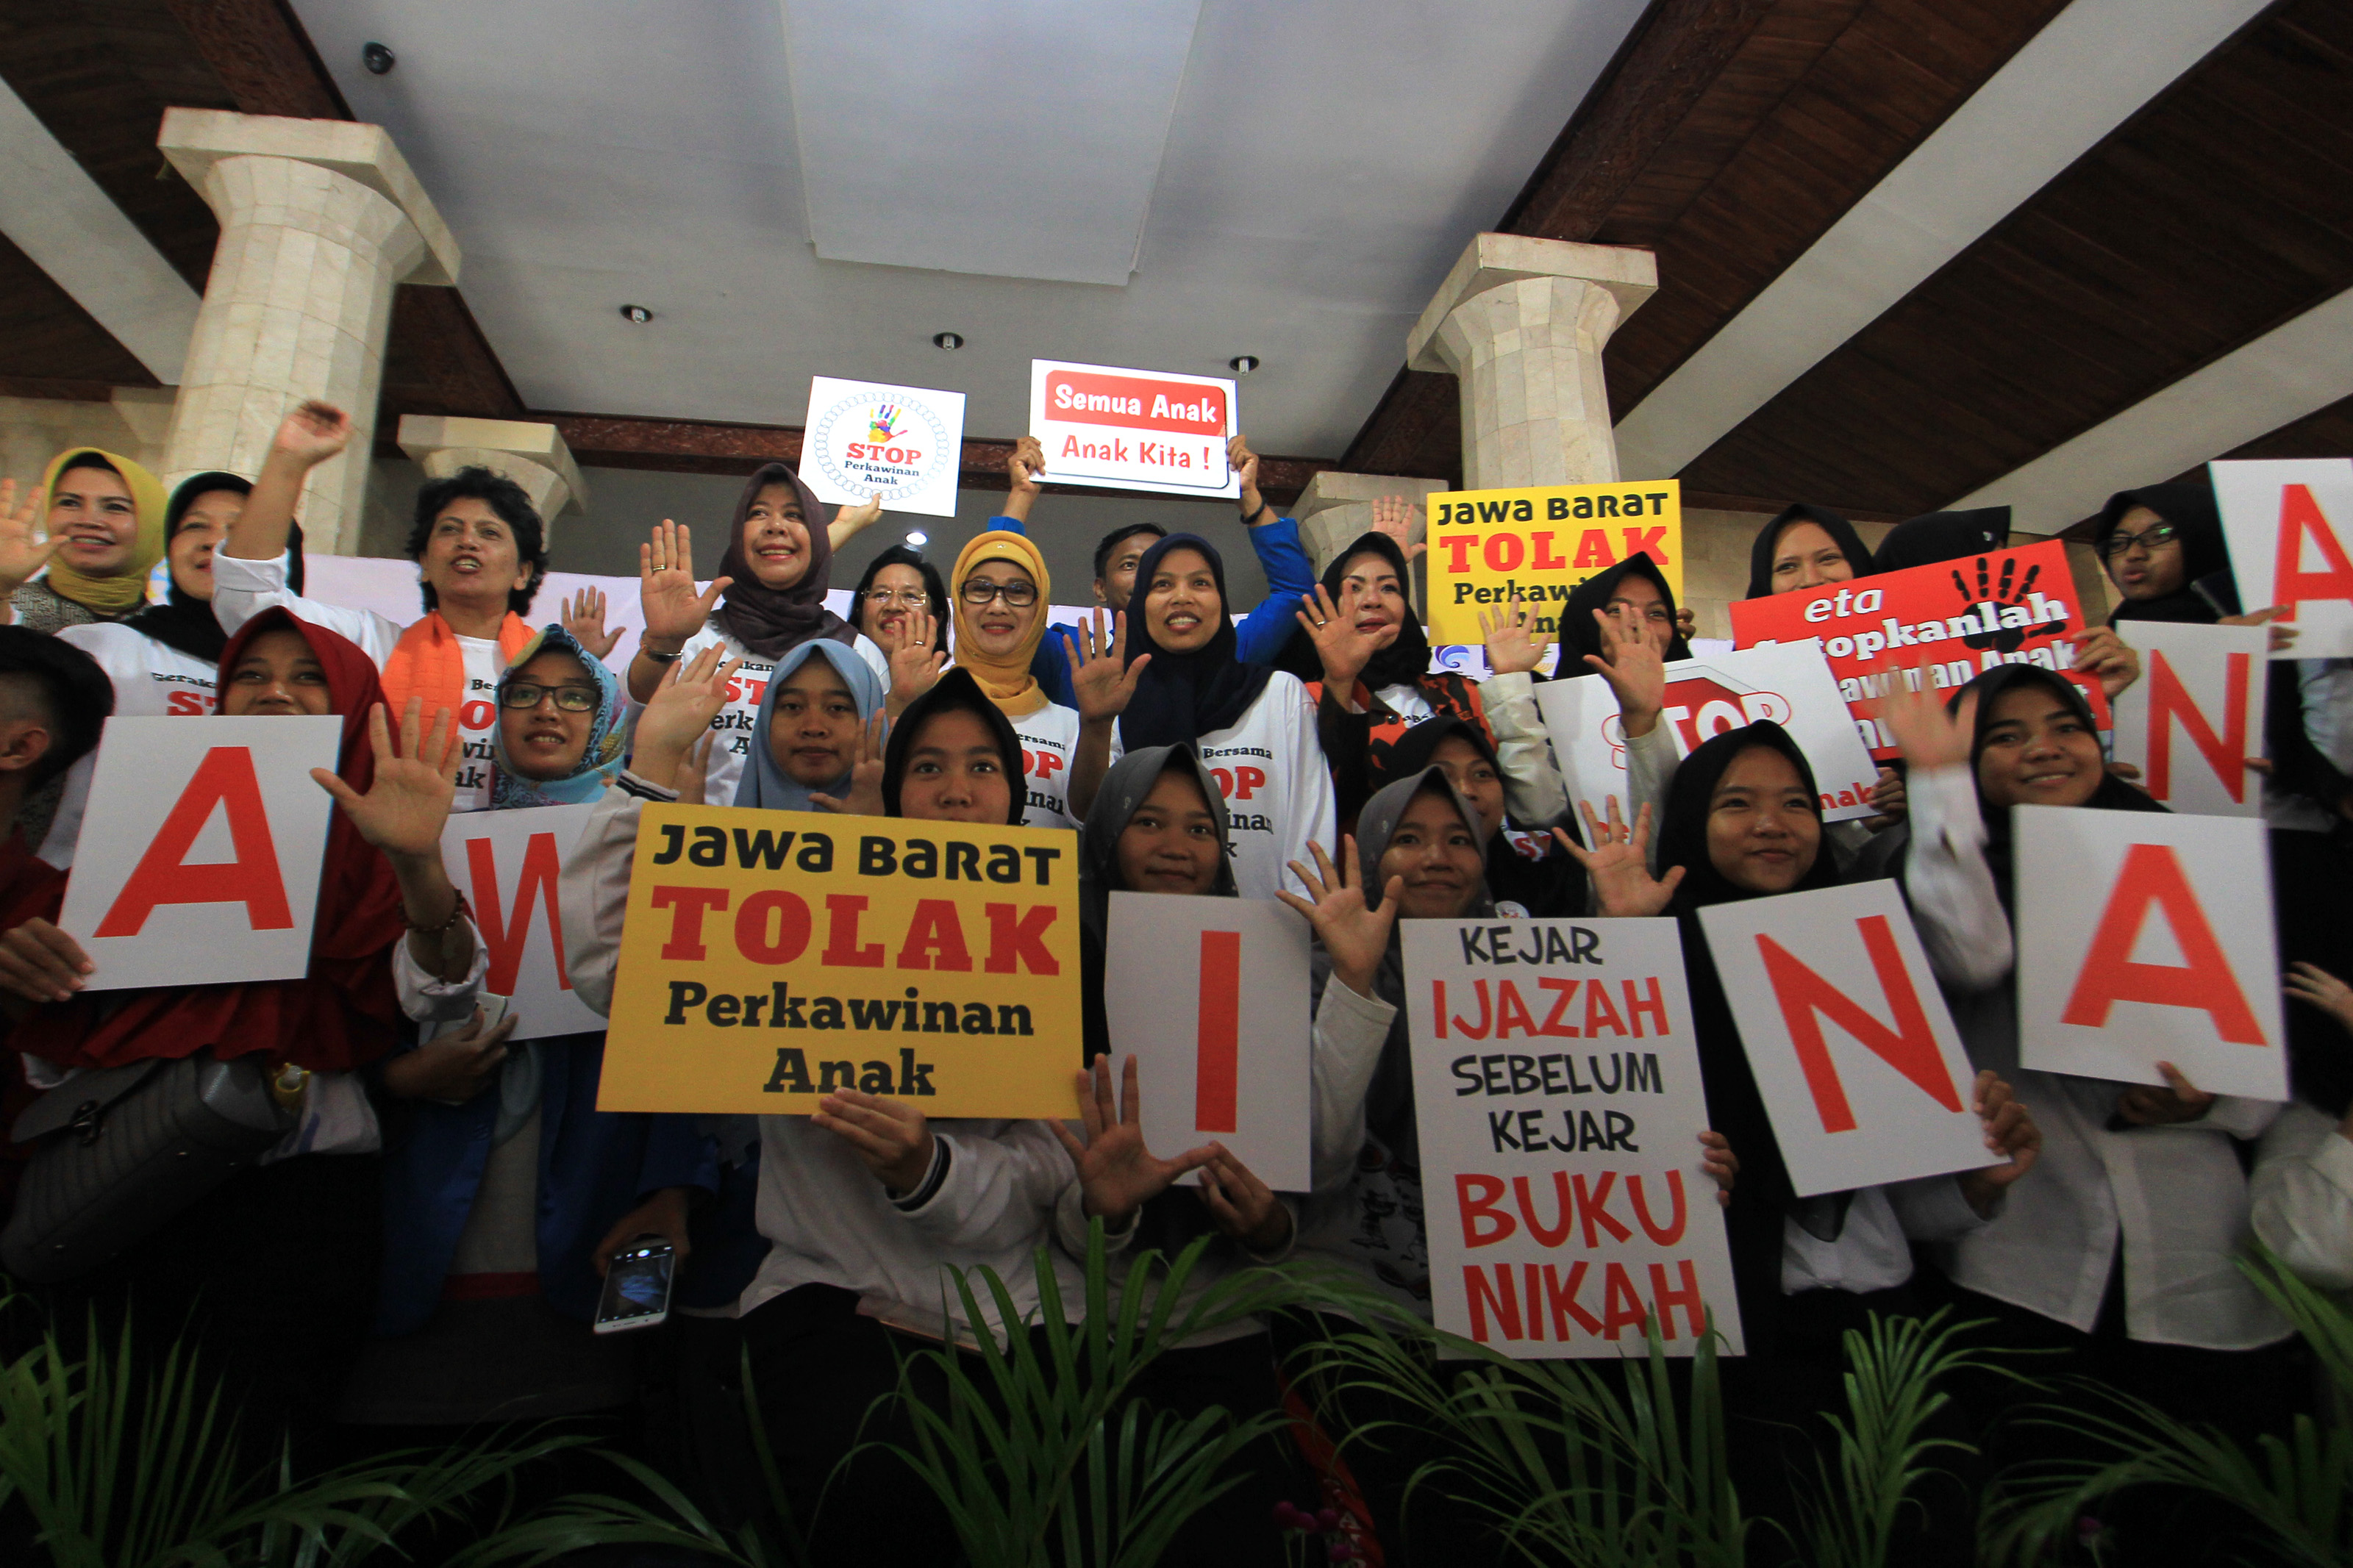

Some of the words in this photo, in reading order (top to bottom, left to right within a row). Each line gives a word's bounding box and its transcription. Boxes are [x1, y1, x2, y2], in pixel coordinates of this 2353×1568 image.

[1054, 384, 1141, 415] Semua
[1151, 394, 1217, 424] Anak
[844, 460, 920, 476] Perkawinan
[846, 443, 921, 465] STOP
[1062, 435, 1128, 462] Anak
[1139, 441, 1192, 469] Kita
[1202, 447, 1210, 470] !
[864, 474, 898, 484] Anak
[1439, 526, 1668, 573] TOLAK
[2271, 484, 2353, 622] A
[1454, 577, 1586, 604] Perkaw
[1804, 588, 1883, 623] eta
[1754, 592, 2068, 659] opkanlah
[2146, 648, 2250, 803] N
[1203, 747, 1273, 759] Bersama
[93, 745, 294, 939] A
[650, 885, 1060, 976] TOLAK
[1460, 926, 1604, 967] KEJAR
[2060, 842, 2269, 1047] A
[664, 981, 1035, 1036] Perkawinan
[1195, 930, 1241, 1133] I
[1432, 976, 1671, 1039] IJAZAH
[1754, 914, 1964, 1134] N
[763, 1047, 936, 1096] Anak
[1451, 1052, 1665, 1097] SEBELUM
[1488, 1109, 1640, 1153] KEJAR
[1454, 1169, 1688, 1250] BUKU
[1463, 1259, 1706, 1343] NIKAH
